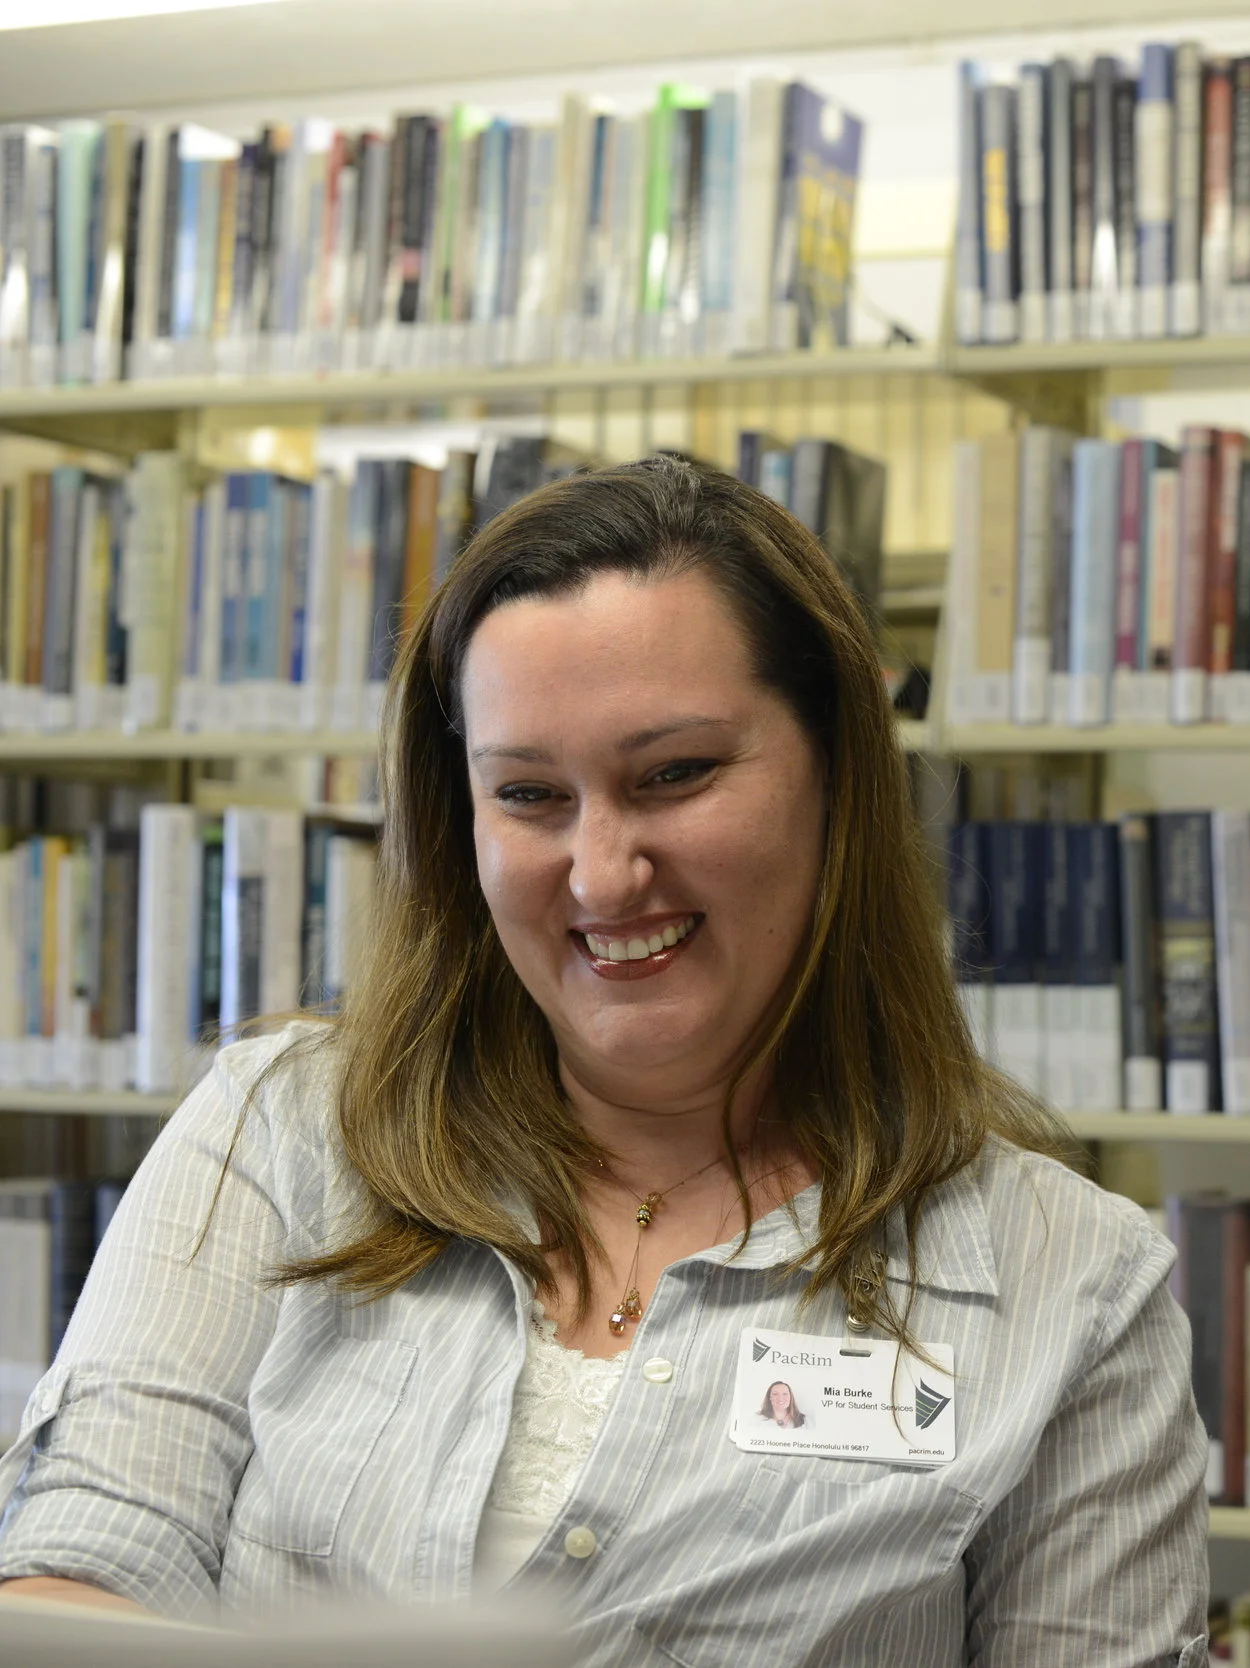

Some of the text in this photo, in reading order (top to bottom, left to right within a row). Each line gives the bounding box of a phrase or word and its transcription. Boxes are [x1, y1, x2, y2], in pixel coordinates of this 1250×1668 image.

[771, 1351, 832, 1367] PacRim
[823, 1387, 873, 1399] Mia Burke
[821, 1400, 914, 1413] VP for Student Services
[812, 1443, 841, 1451] Honolulu
[908, 1448, 945, 1456] pacrim.edu
